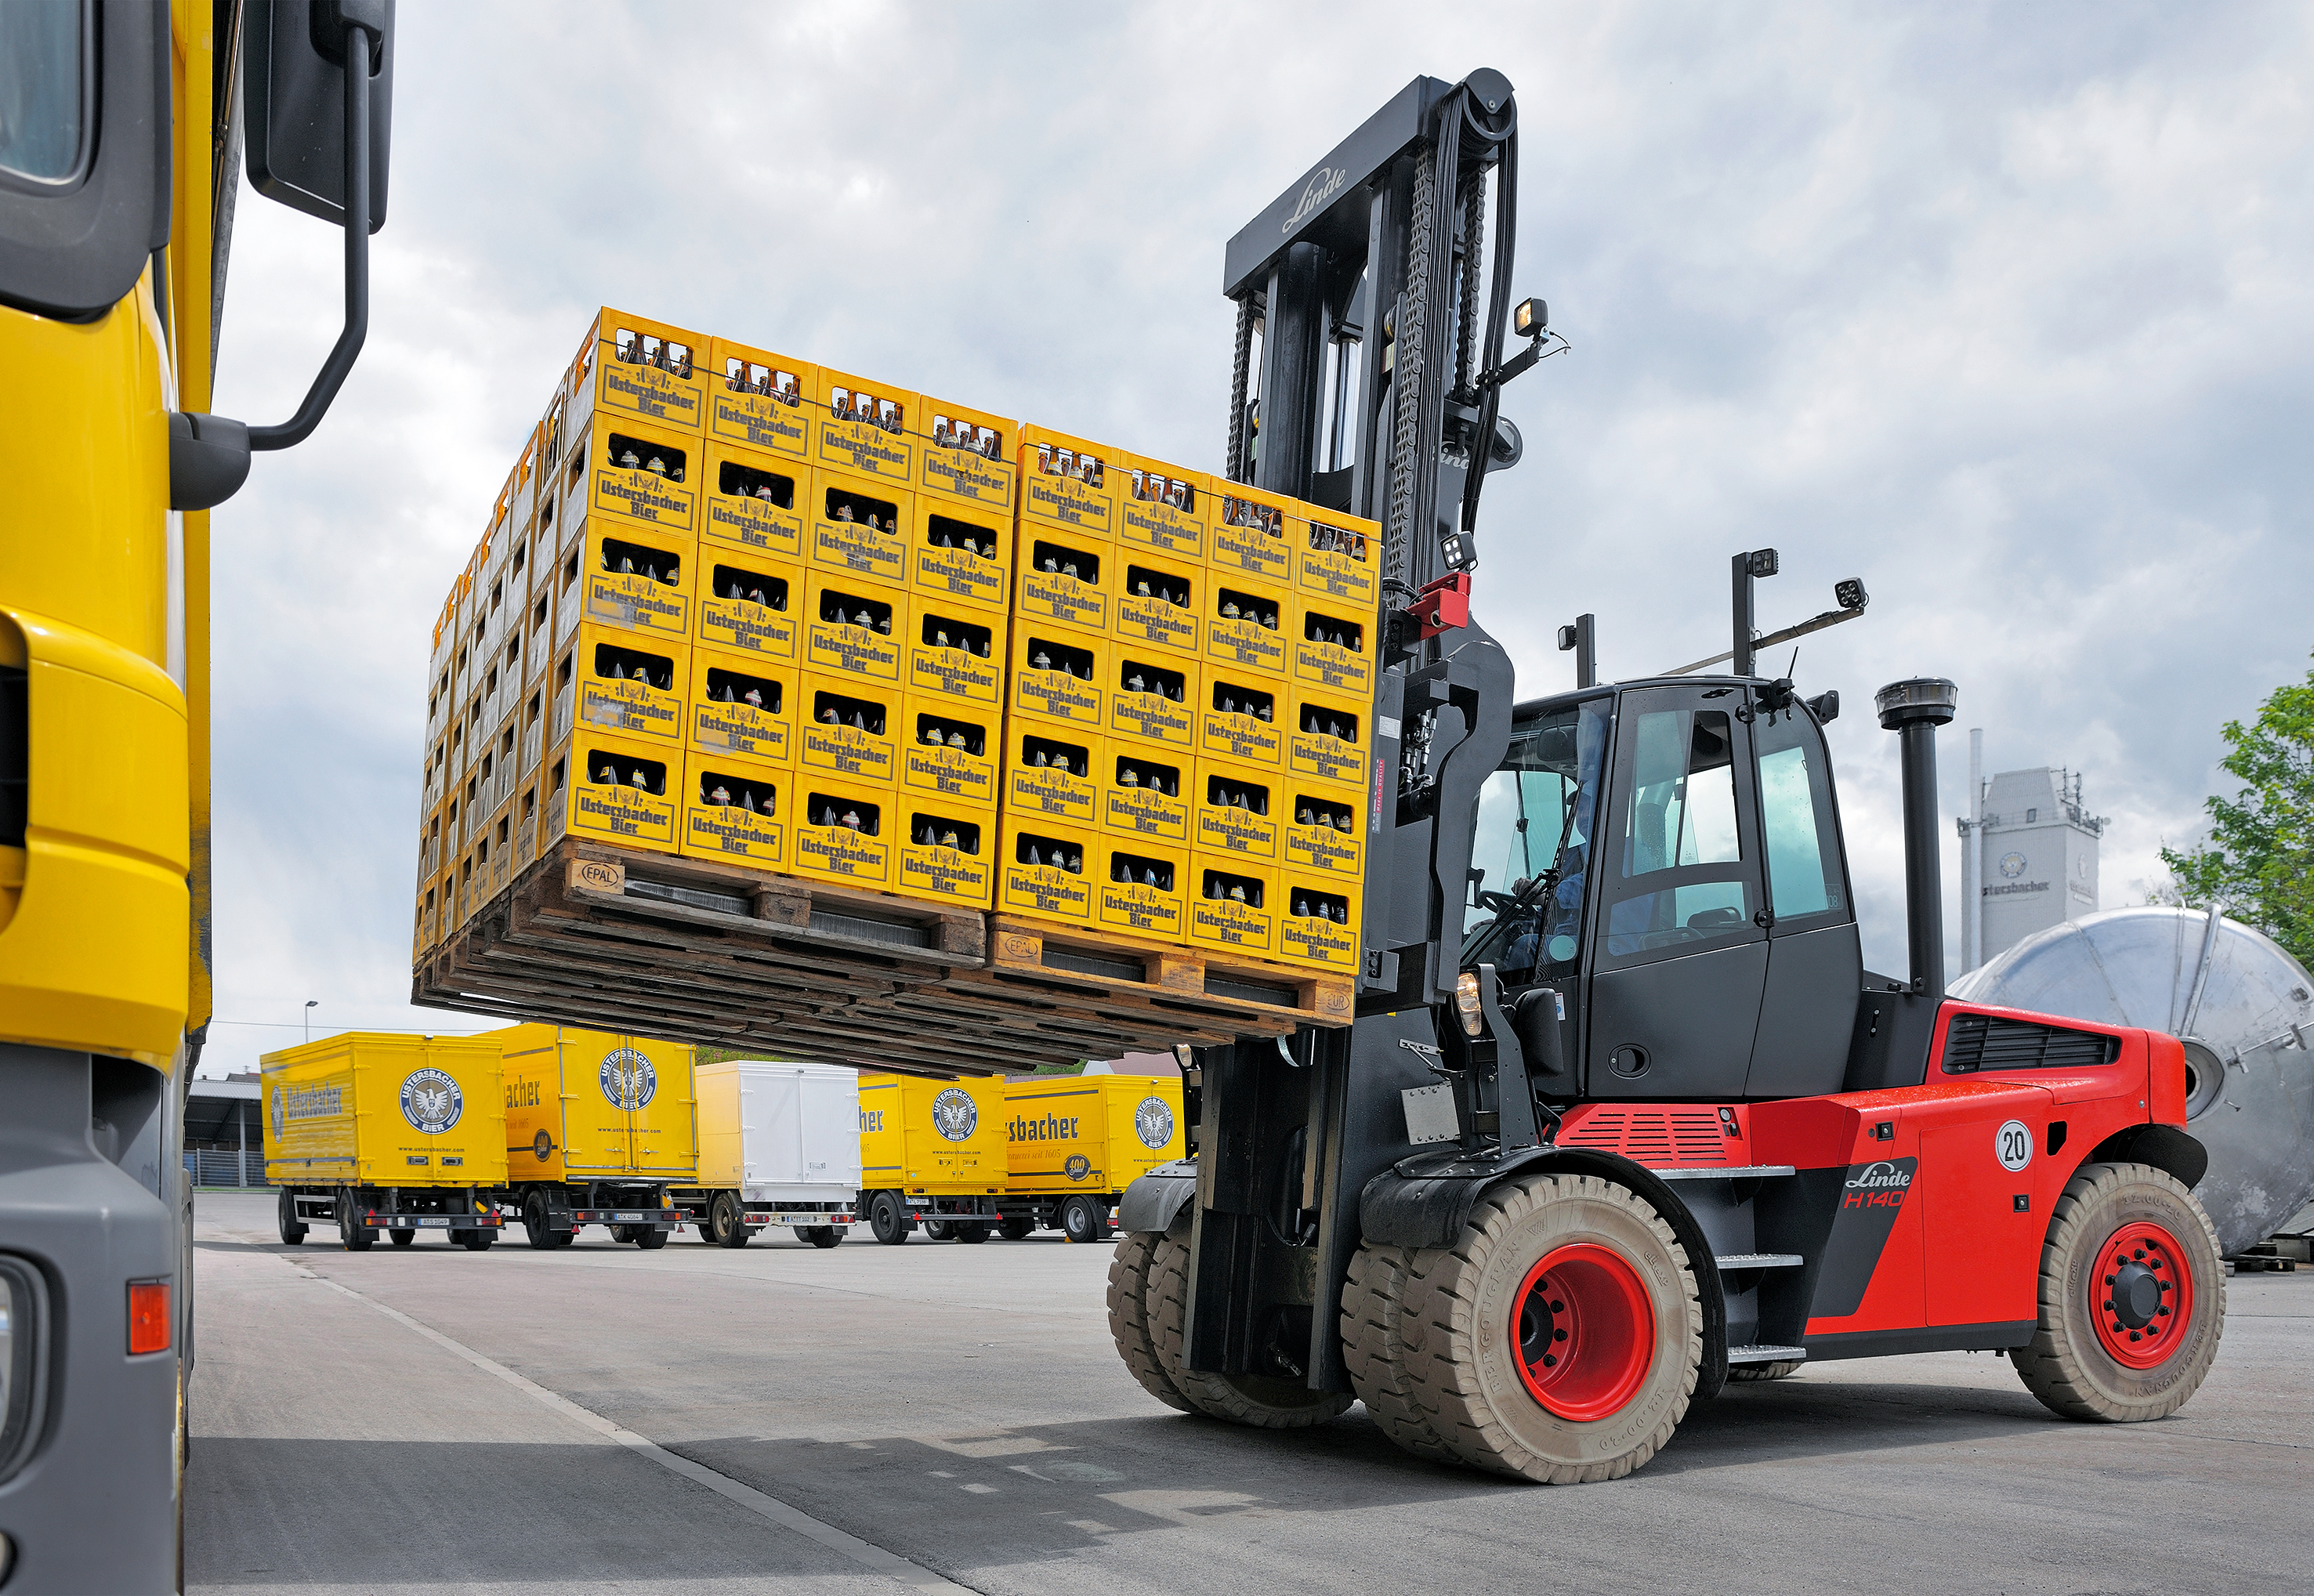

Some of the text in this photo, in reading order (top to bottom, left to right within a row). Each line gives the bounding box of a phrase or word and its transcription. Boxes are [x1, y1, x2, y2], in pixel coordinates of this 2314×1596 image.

[1282, 167, 1346, 233] Linde
[609, 374, 695, 411] Ustersbacher
[637, 396, 666, 416] Bier
[719, 404, 802, 440] Ustersbacher
[746, 425, 774, 445] Bier
[825, 431, 905, 465] Ustersbacher
[852, 451, 878, 471] Bier
[601, 479, 687, 514] Ustersbacher
[953, 479, 979, 497] Bier
[629, 501, 658, 520] Bier
[1032, 485, 1106, 517] Ustersbacher
[712, 506, 796, 540] Ustersbacher
[1056, 505, 1081, 523] Bier
[1126, 511, 1198, 541] Ustersbacher
[740, 527, 768, 546] Bier
[819, 532, 900, 565] Ustersbacher
[1150, 530, 1174, 548] Bier
[1217, 536, 1286, 565] Ustersbacher
[1240, 554, 1263, 571] Bier
[922, 556, 998, 588] Ustersbacher
[1304, 561, 1371, 589] Ustersbacher
[947, 577, 973, 595] Bier
[1027, 583, 1101, 613] Ustersbacher
[1326, 578, 1348, 595] Bier
[1052, 603, 1076, 620] Bier
[1121, 606, 1193, 635] Ustersbacher
[707, 610, 790, 642] Ustersbacher
[1145, 625, 1169, 642] Bier
[734, 630, 762, 649] Bier
[813, 634, 894, 664] Ustersbacher
[1212, 629, 1281, 657] Ustersbacher
[840, 653, 867, 671] Bier
[1235, 647, 1258, 664] Bier
[1299, 651, 1365, 679] Ustersbacher
[916, 657, 993, 687] Ustersbacher
[1321, 669, 1343, 686] Bier
[941, 677, 967, 694] Bier
[1022, 681, 1096, 709] Ustersbacher
[1046, 699, 1071, 716] Bier
[1116, 703, 1188, 730] Ustersbacher
[700, 714, 784, 744] Ustersbacher
[1140, 721, 1164, 737] Bier
[1208, 722, 1277, 750] Ustersbacher
[807, 735, 889, 765] Ustersbacher
[1230, 740, 1254, 757] Bier
[1295, 744, 1360, 770] Ustersbacher
[835, 755, 861, 773] Bier
[910, 757, 988, 786] Ustersbacher
[1316, 761, 1338, 777] Bier
[936, 776, 961, 793] Bier
[1016, 778, 1090, 805] Ustersbacher
[580, 797, 668, 826] Ustersbacher
[1041, 796, 1066, 813] Bier
[1110, 798, 1182, 825] Ustersbacher
[610, 816, 639, 834] Bier
[693, 816, 777, 845] Ustersbacher
[1134, 816, 1158, 833] Bier
[1202, 816, 1271, 843] Ustersbacher
[720, 836, 748, 853] Bier
[801, 838, 882, 866] Ustersbacher
[1225, 834, 1248, 850] Bier
[1289, 835, 1356, 860] Ustersbacher
[828, 856, 855, 874] Bier
[905, 857, 983, 885] Ustersbacher
[1311, 852, 1334, 868] Bier
[586, 866, 615, 884] EPAL
[931, 875, 957, 892] Bier
[1010, 876, 1085, 903] Ustersbacher
[1035, 894, 1060, 910] Bier
[1105, 895, 1176, 920] Ustersbacher
[1128, 912, 1153, 928] Bier
[1197, 910, 1266, 935] Ustersbacher
[1009, 940, 1035, 954] EPAL
[1219, 927, 1243, 943] Bier
[1284, 928, 1352, 952] Ustersbacher
[1306, 944, 1329, 960] Bier
[402, 1069, 461, 1100] USTERSBACHER
[503, 1075, 540, 1109] acher
[933, 1089, 976, 1114] USTERSBACHER
[1135, 1098, 1172, 1121] USTERSBACHER
[422, 1123, 444, 1132] BIER
[1045, 1149, 1061, 1159] 1605
[2003, 1131, 2026, 1162] 20
[1069, 1159, 1085, 1171] 400
[1845, 1162, 1910, 1188] Linde
